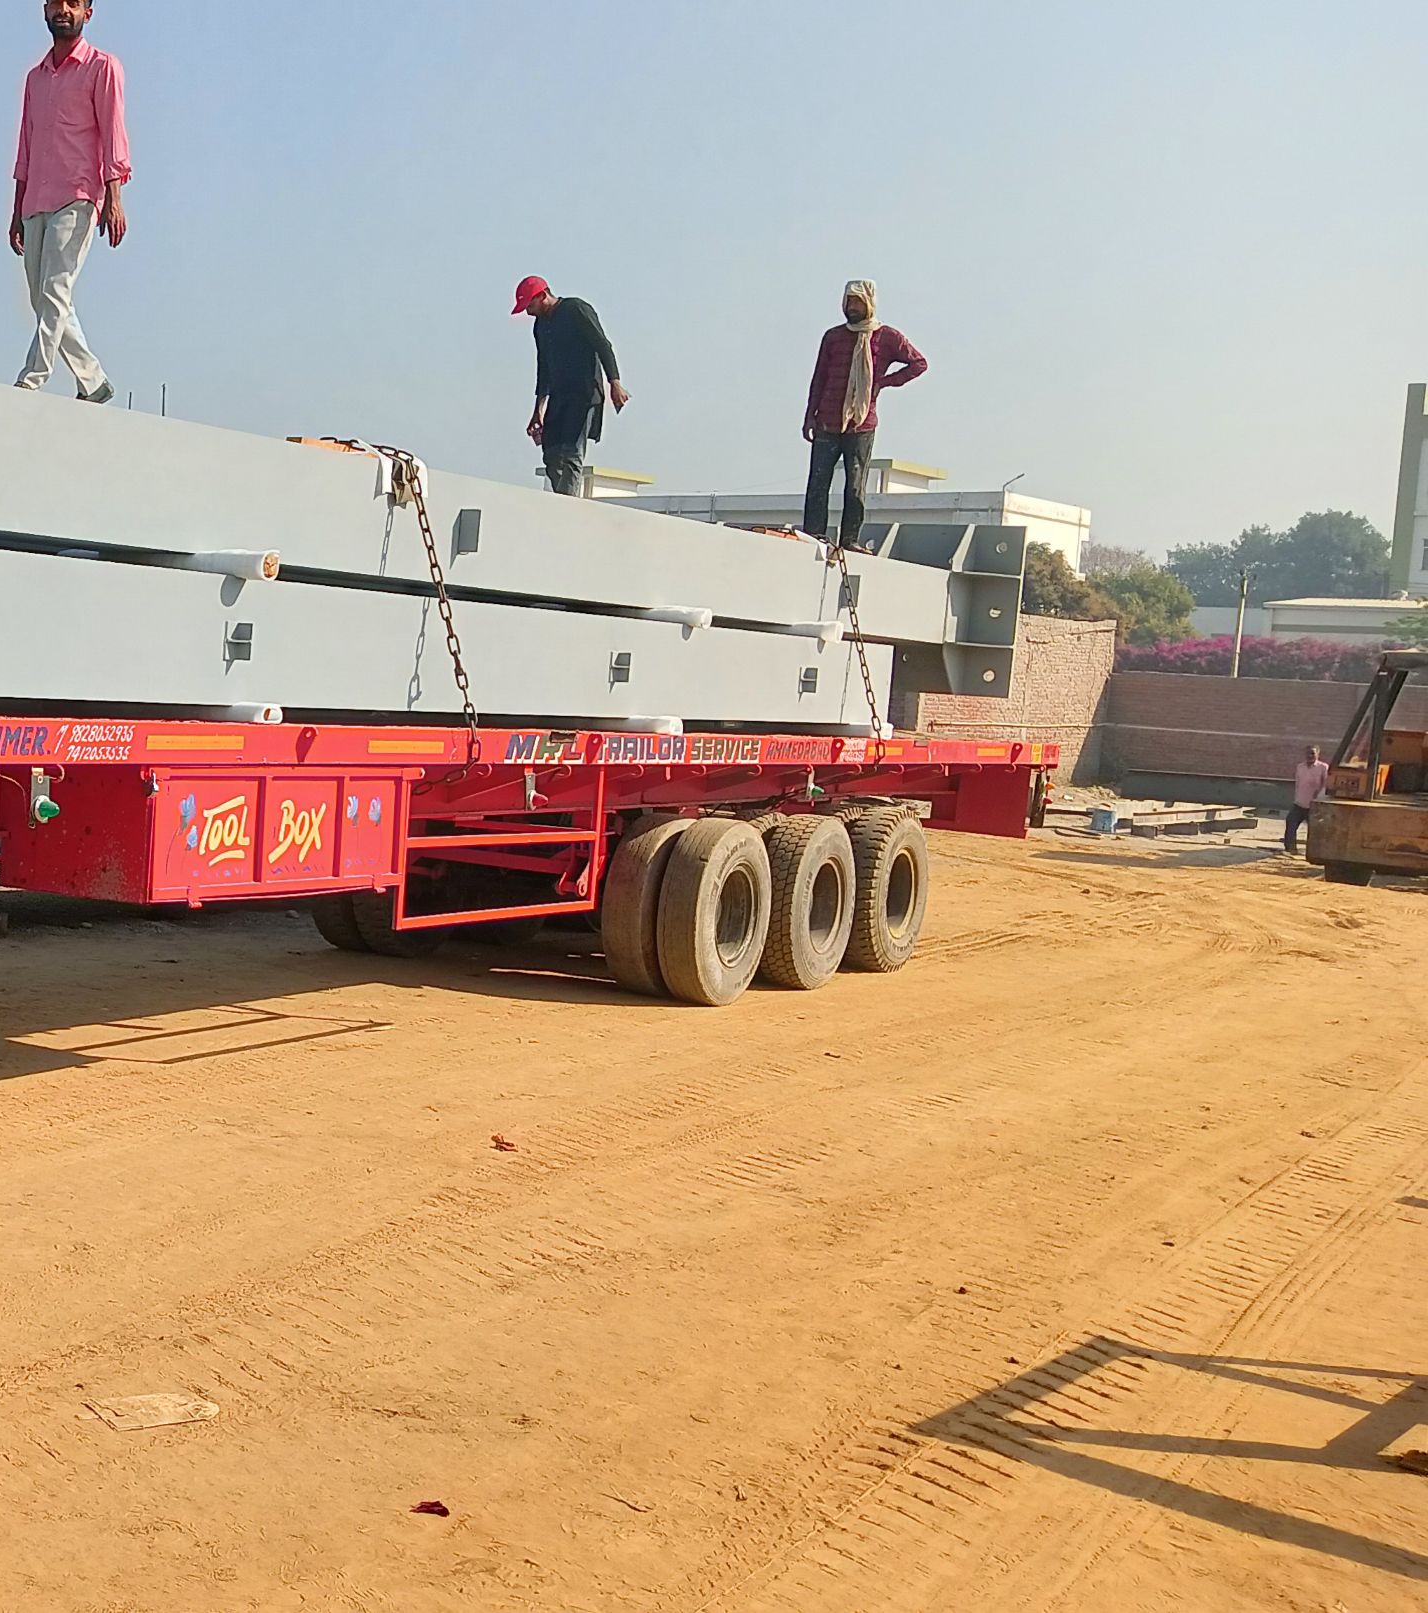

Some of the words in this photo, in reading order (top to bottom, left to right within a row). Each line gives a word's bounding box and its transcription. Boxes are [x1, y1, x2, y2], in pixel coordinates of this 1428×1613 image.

[690, 735, 761, 764] SERVICE
[766, 740, 831, 760] AHMEDABAD
[198, 795, 250, 856] TOOL
[267, 798, 327, 864] BOX
